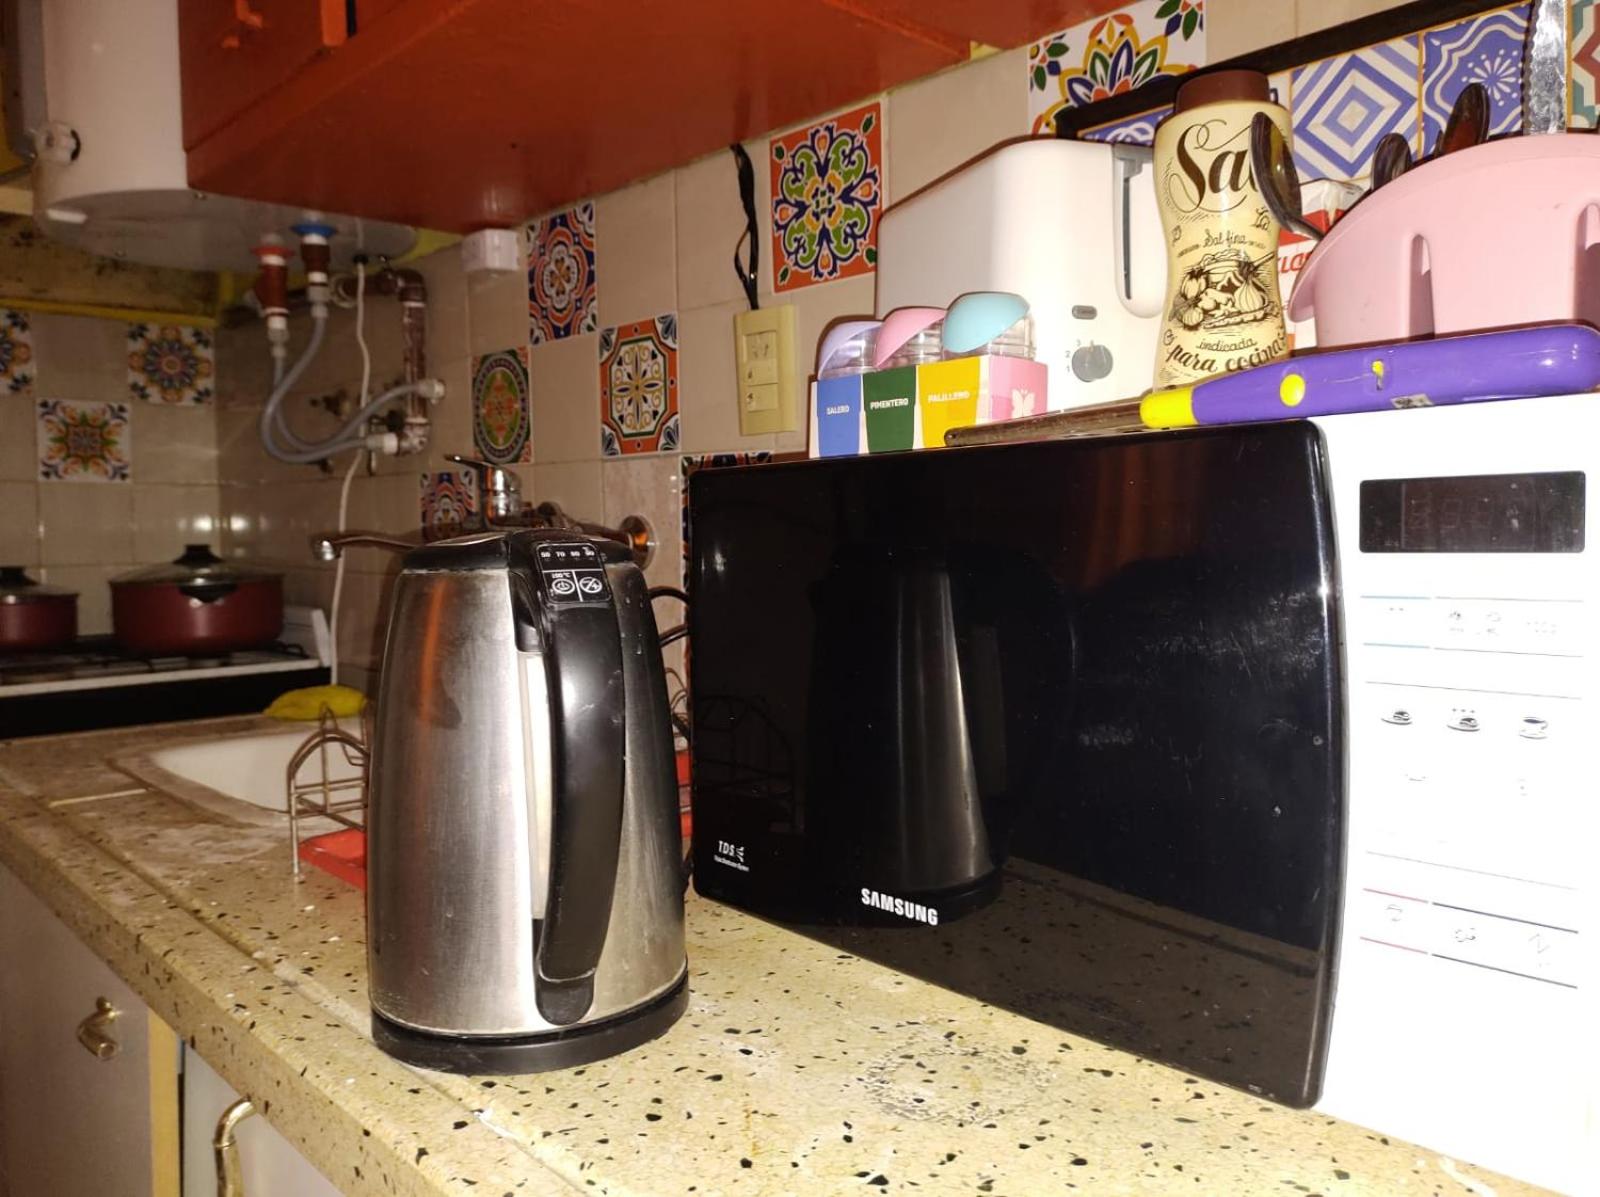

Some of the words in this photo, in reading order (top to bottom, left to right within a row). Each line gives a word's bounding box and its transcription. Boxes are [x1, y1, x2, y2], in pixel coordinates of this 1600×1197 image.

[1168, 119, 1259, 214] Sa
[1203, 228, 1223, 248] Sal
[1224, 230, 1247, 248] fina
[1196, 337, 1257, 352] indicada
[1165, 344, 1218, 372] para
[826, 404, 850, 416] SALERO
[869, 397, 909, 410] PIMENTERO
[928, 390, 970, 404] PALILLERO
[718, 839, 735, 857] TDS
[860, 887, 939, 927] SAMSUNG
